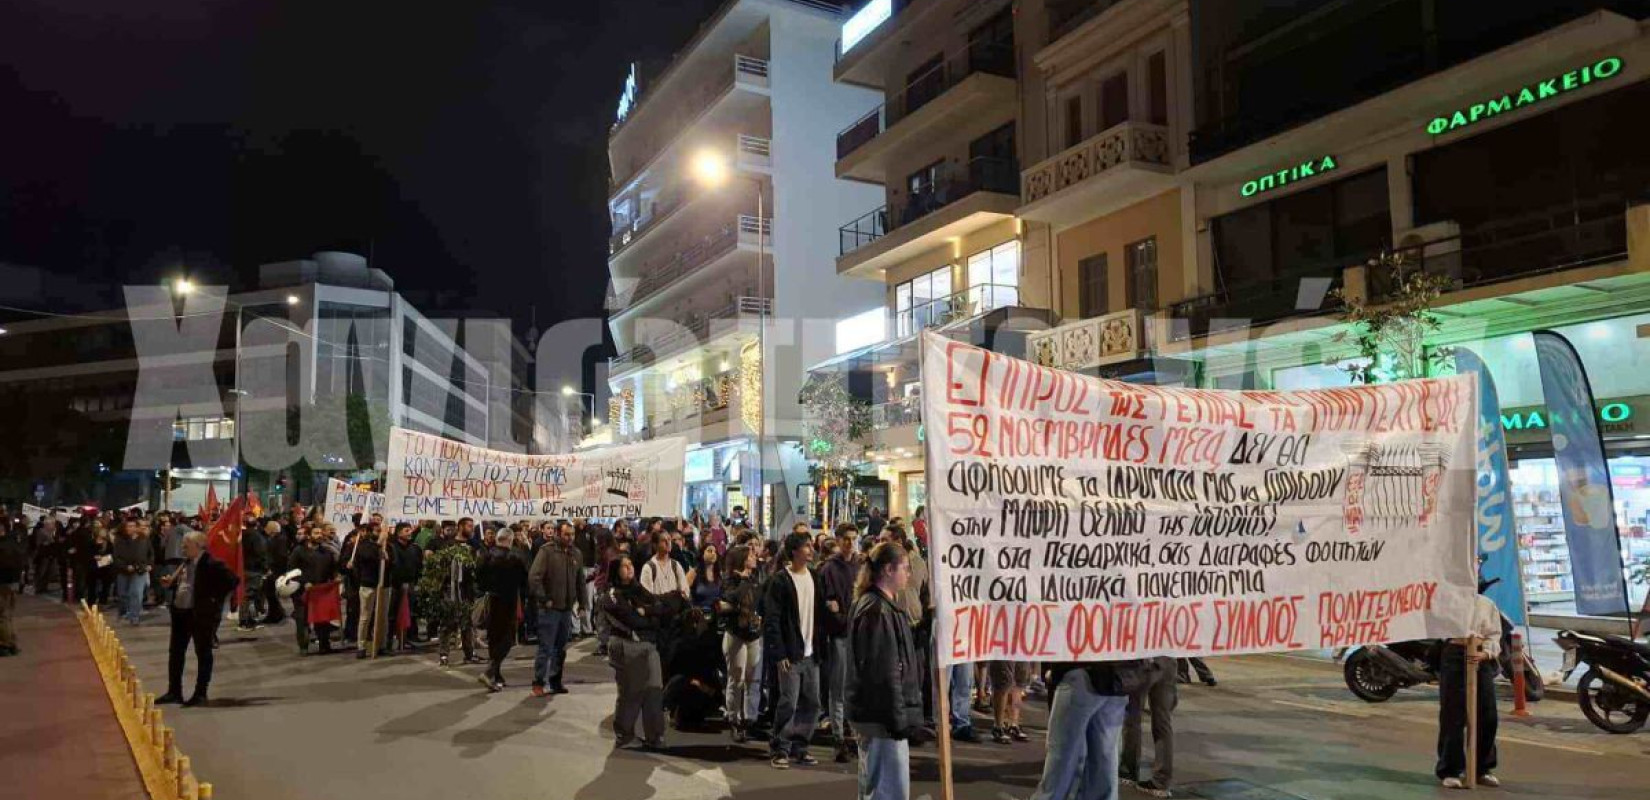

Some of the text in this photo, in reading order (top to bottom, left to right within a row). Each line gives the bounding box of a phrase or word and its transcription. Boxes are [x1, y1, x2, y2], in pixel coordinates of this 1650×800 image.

[1427, 56, 1622, 135] ΦΑΡΜΑΚΕΙΟ
[1241, 155, 1336, 197] ΟΠΤΙΚΑ
[948, 412, 991, 457] 52
[403, 457, 459, 477] ΚΟΝΤΡΑ
[404, 475, 434, 495] ΤΟΥ
[443, 478, 508, 501] ΚΕΡΔΟΥΣ
[509, 480, 532, 501] ΚΑΙ
[536, 483, 567, 501] ΤΗΣ
[952, 582, 1438, 661] ΕΝΙΑΙΟΣ ΦΟΙΤΗΤΙΚΟΣ ΣΥΛΛΟΓΟΣ ΠΟΛΥΤΕΧΝΕΙΟΥ
[1319, 619, 1390, 648] ΚΡΗΤΗΣ
